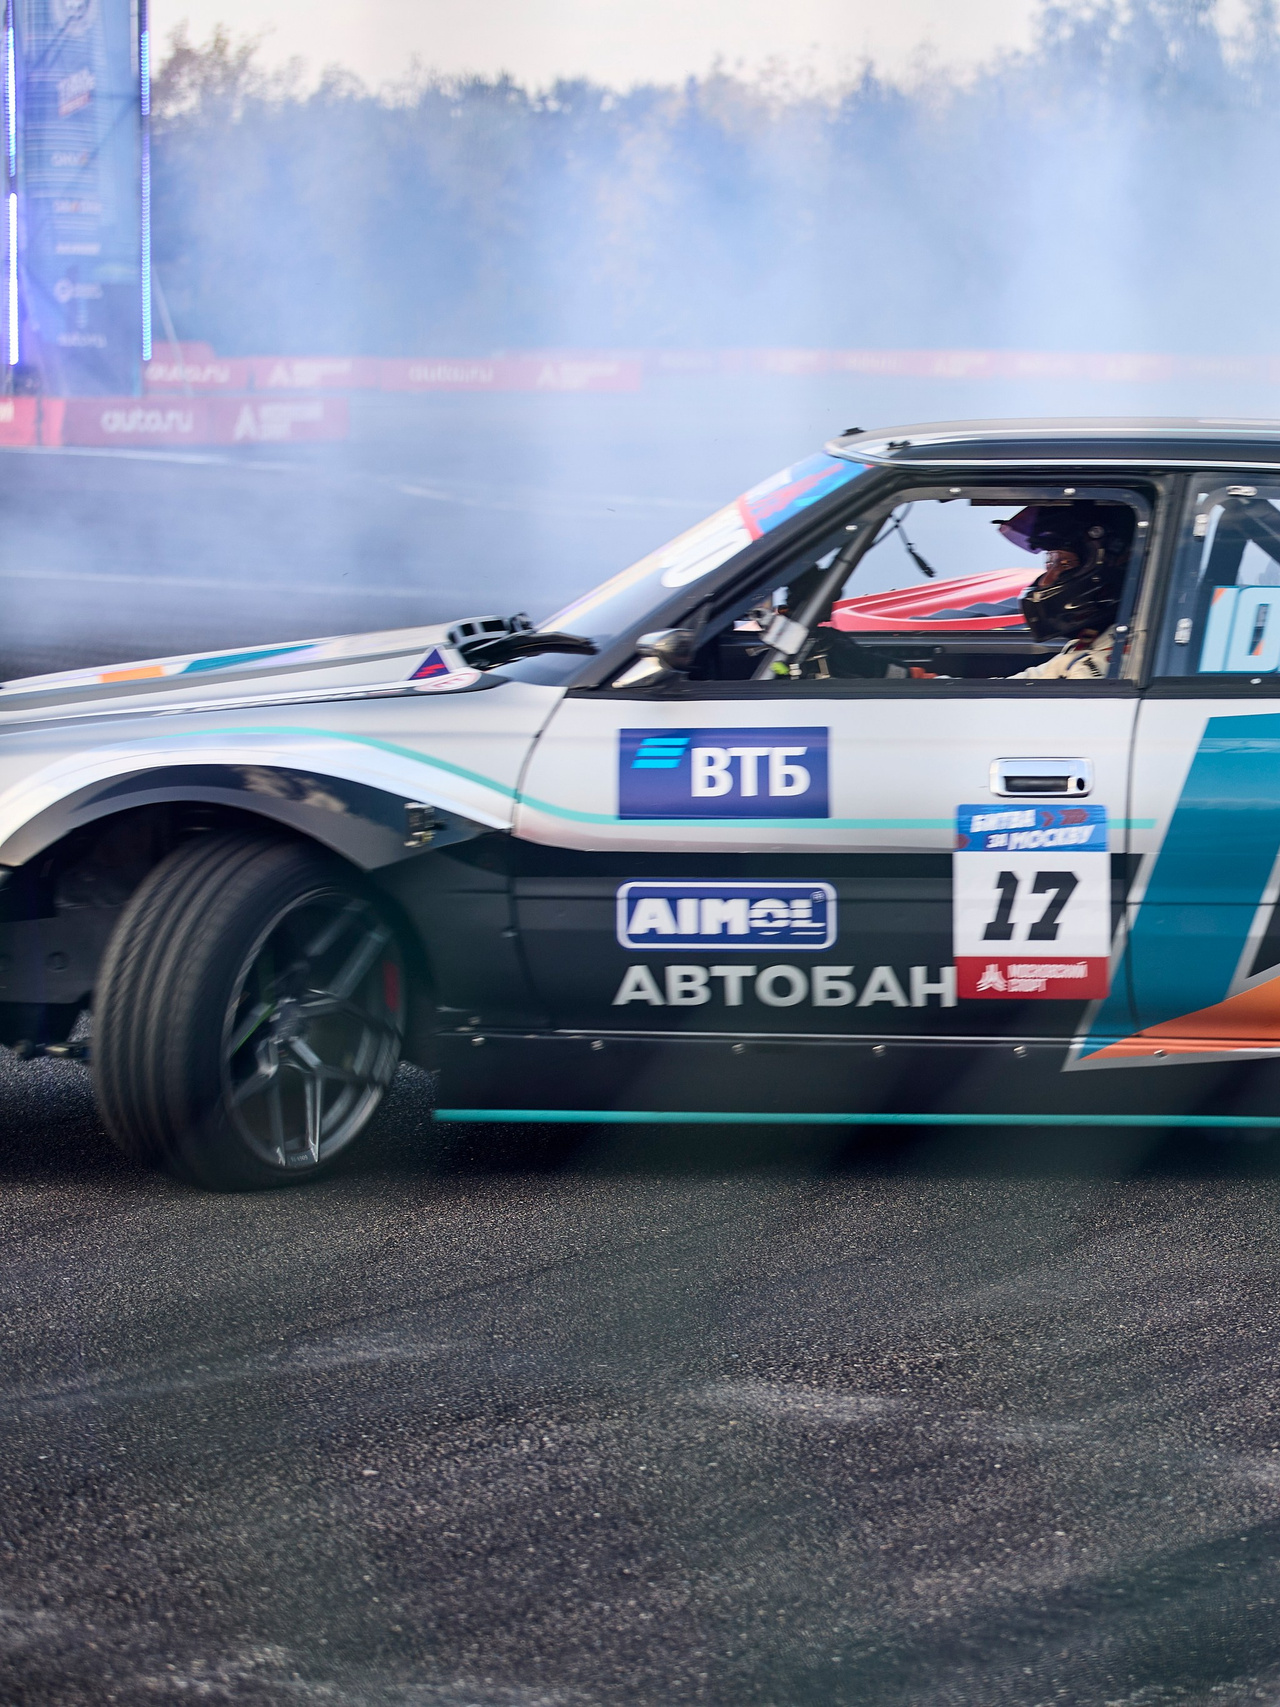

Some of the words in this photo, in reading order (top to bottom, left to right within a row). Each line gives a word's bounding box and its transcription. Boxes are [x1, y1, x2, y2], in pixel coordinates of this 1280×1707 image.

[100, 406, 194, 434] auto.ru
[690, 746, 812, 798] ВТБ
[626, 898, 827, 935] AIMOL
[980, 870, 1080, 941] 17
[612, 964, 958, 1008] АВТОБАН
